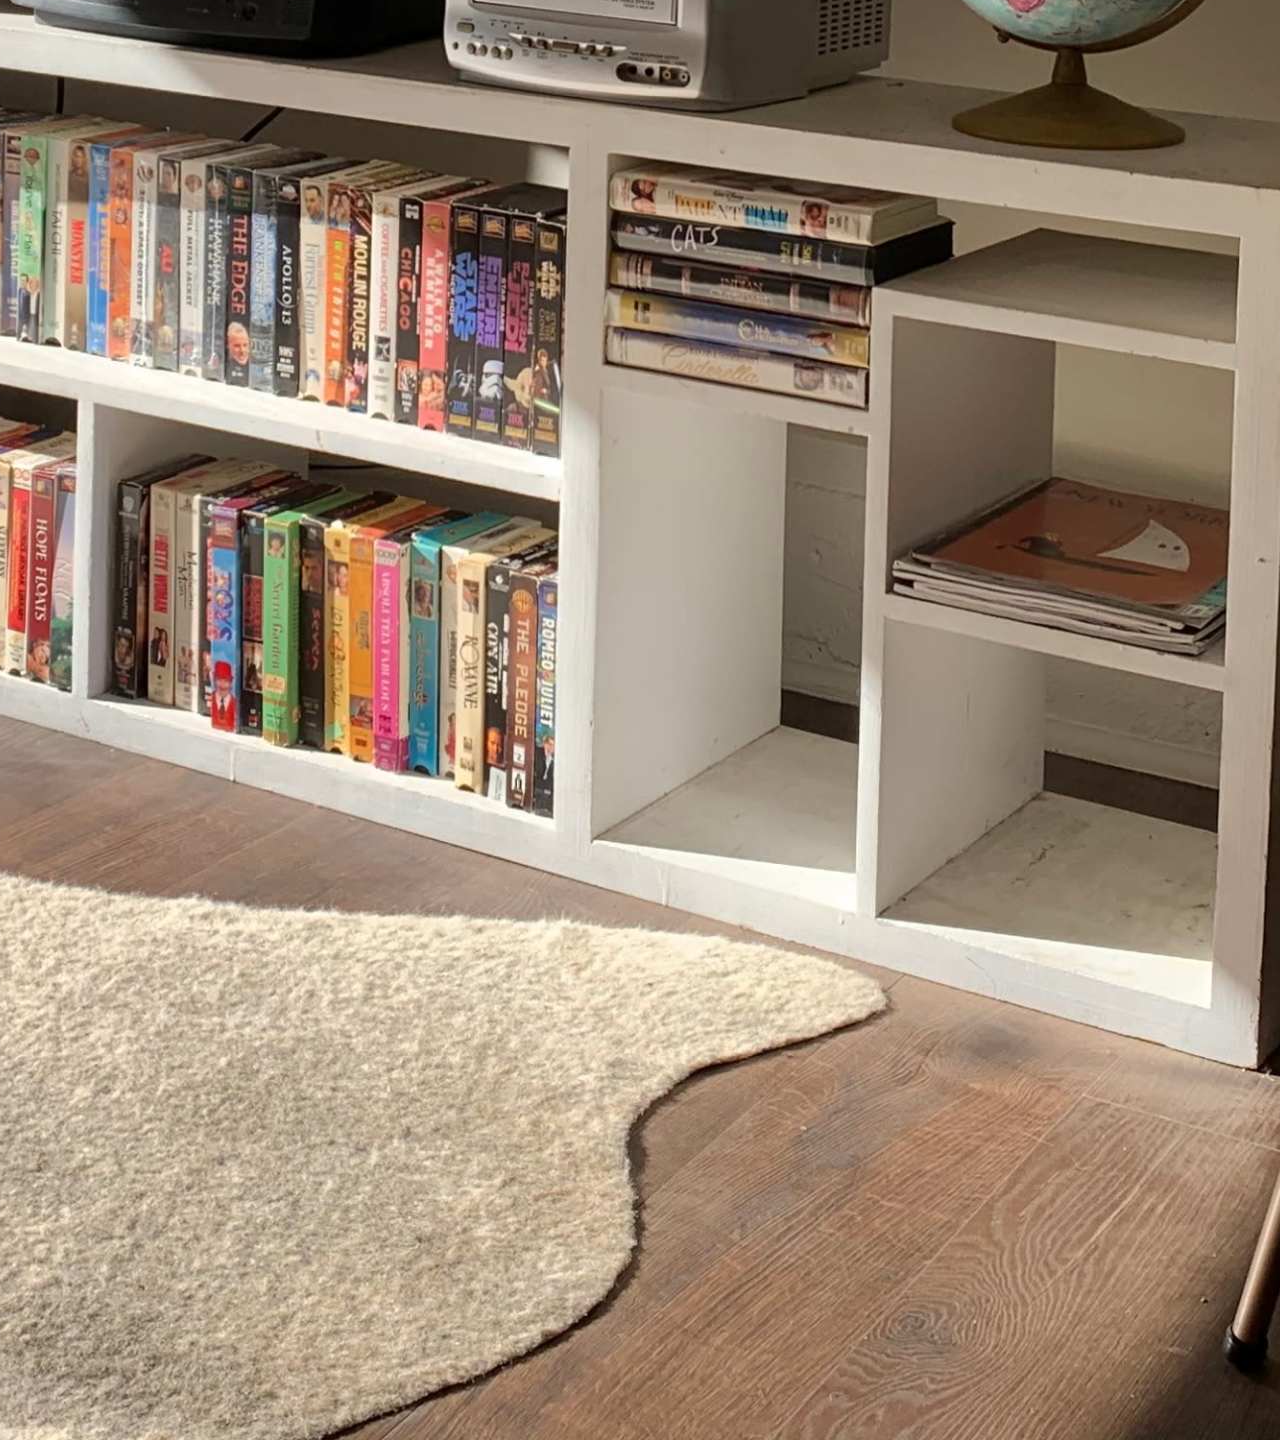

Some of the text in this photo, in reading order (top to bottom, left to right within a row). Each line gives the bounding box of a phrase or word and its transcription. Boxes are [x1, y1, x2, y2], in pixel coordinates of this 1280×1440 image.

[24, 234, 33, 256] Mail
[51, 209, 62, 229] TAI
[51, 231, 62, 255] CHI
[70, 218, 85, 284] MONSTER
[380, 223, 390, 259] COFFEE
[672, 224, 720, 253] CATS
[161, 244, 173, 273] ALI
[213, 218, 225, 306] SHAWSHANK
[231, 215, 248, 315] THE EDGE
[281, 245, 293, 324] APOLLO 13
[303, 243, 320, 335] Forrest Gump
[330, 239, 345, 350] wild things
[352, 234, 369, 351] MOULIN ROUGE
[399, 247, 413, 330] CHICAGO
[434, 249, 444, 334] A WALK TO
[454, 252, 469, 341] WARS
[465, 259, 477, 336] STAR
[379, 275, 389, 331] CIGARETTES
[424, 257, 435, 350] REMEMBER
[476, 310, 484, 345] BACK
[484, 256, 500, 348] EMPIRE
[505, 276, 521, 353] JEDI
[519, 262, 531, 353] RETURN
[661, 343, 762, 387] Cinderella
[34, 518, 48, 621] HOPE FLOATS
[154, 534, 169, 615] PRETTY WOMAN
[214, 571, 233, 642] TOYS
[273, 581, 282, 618] Secret
[272, 623, 282, 669] Garden
[380, 571, 391, 711] ABSOLUTELY FABULOUS
[460, 635, 481, 709] ROXANNE
[487, 623, 498, 693] CON AIR
[514, 618, 529, 737] THE PLEDGE
[540, 617, 554, 727] ROMEO JULIET
